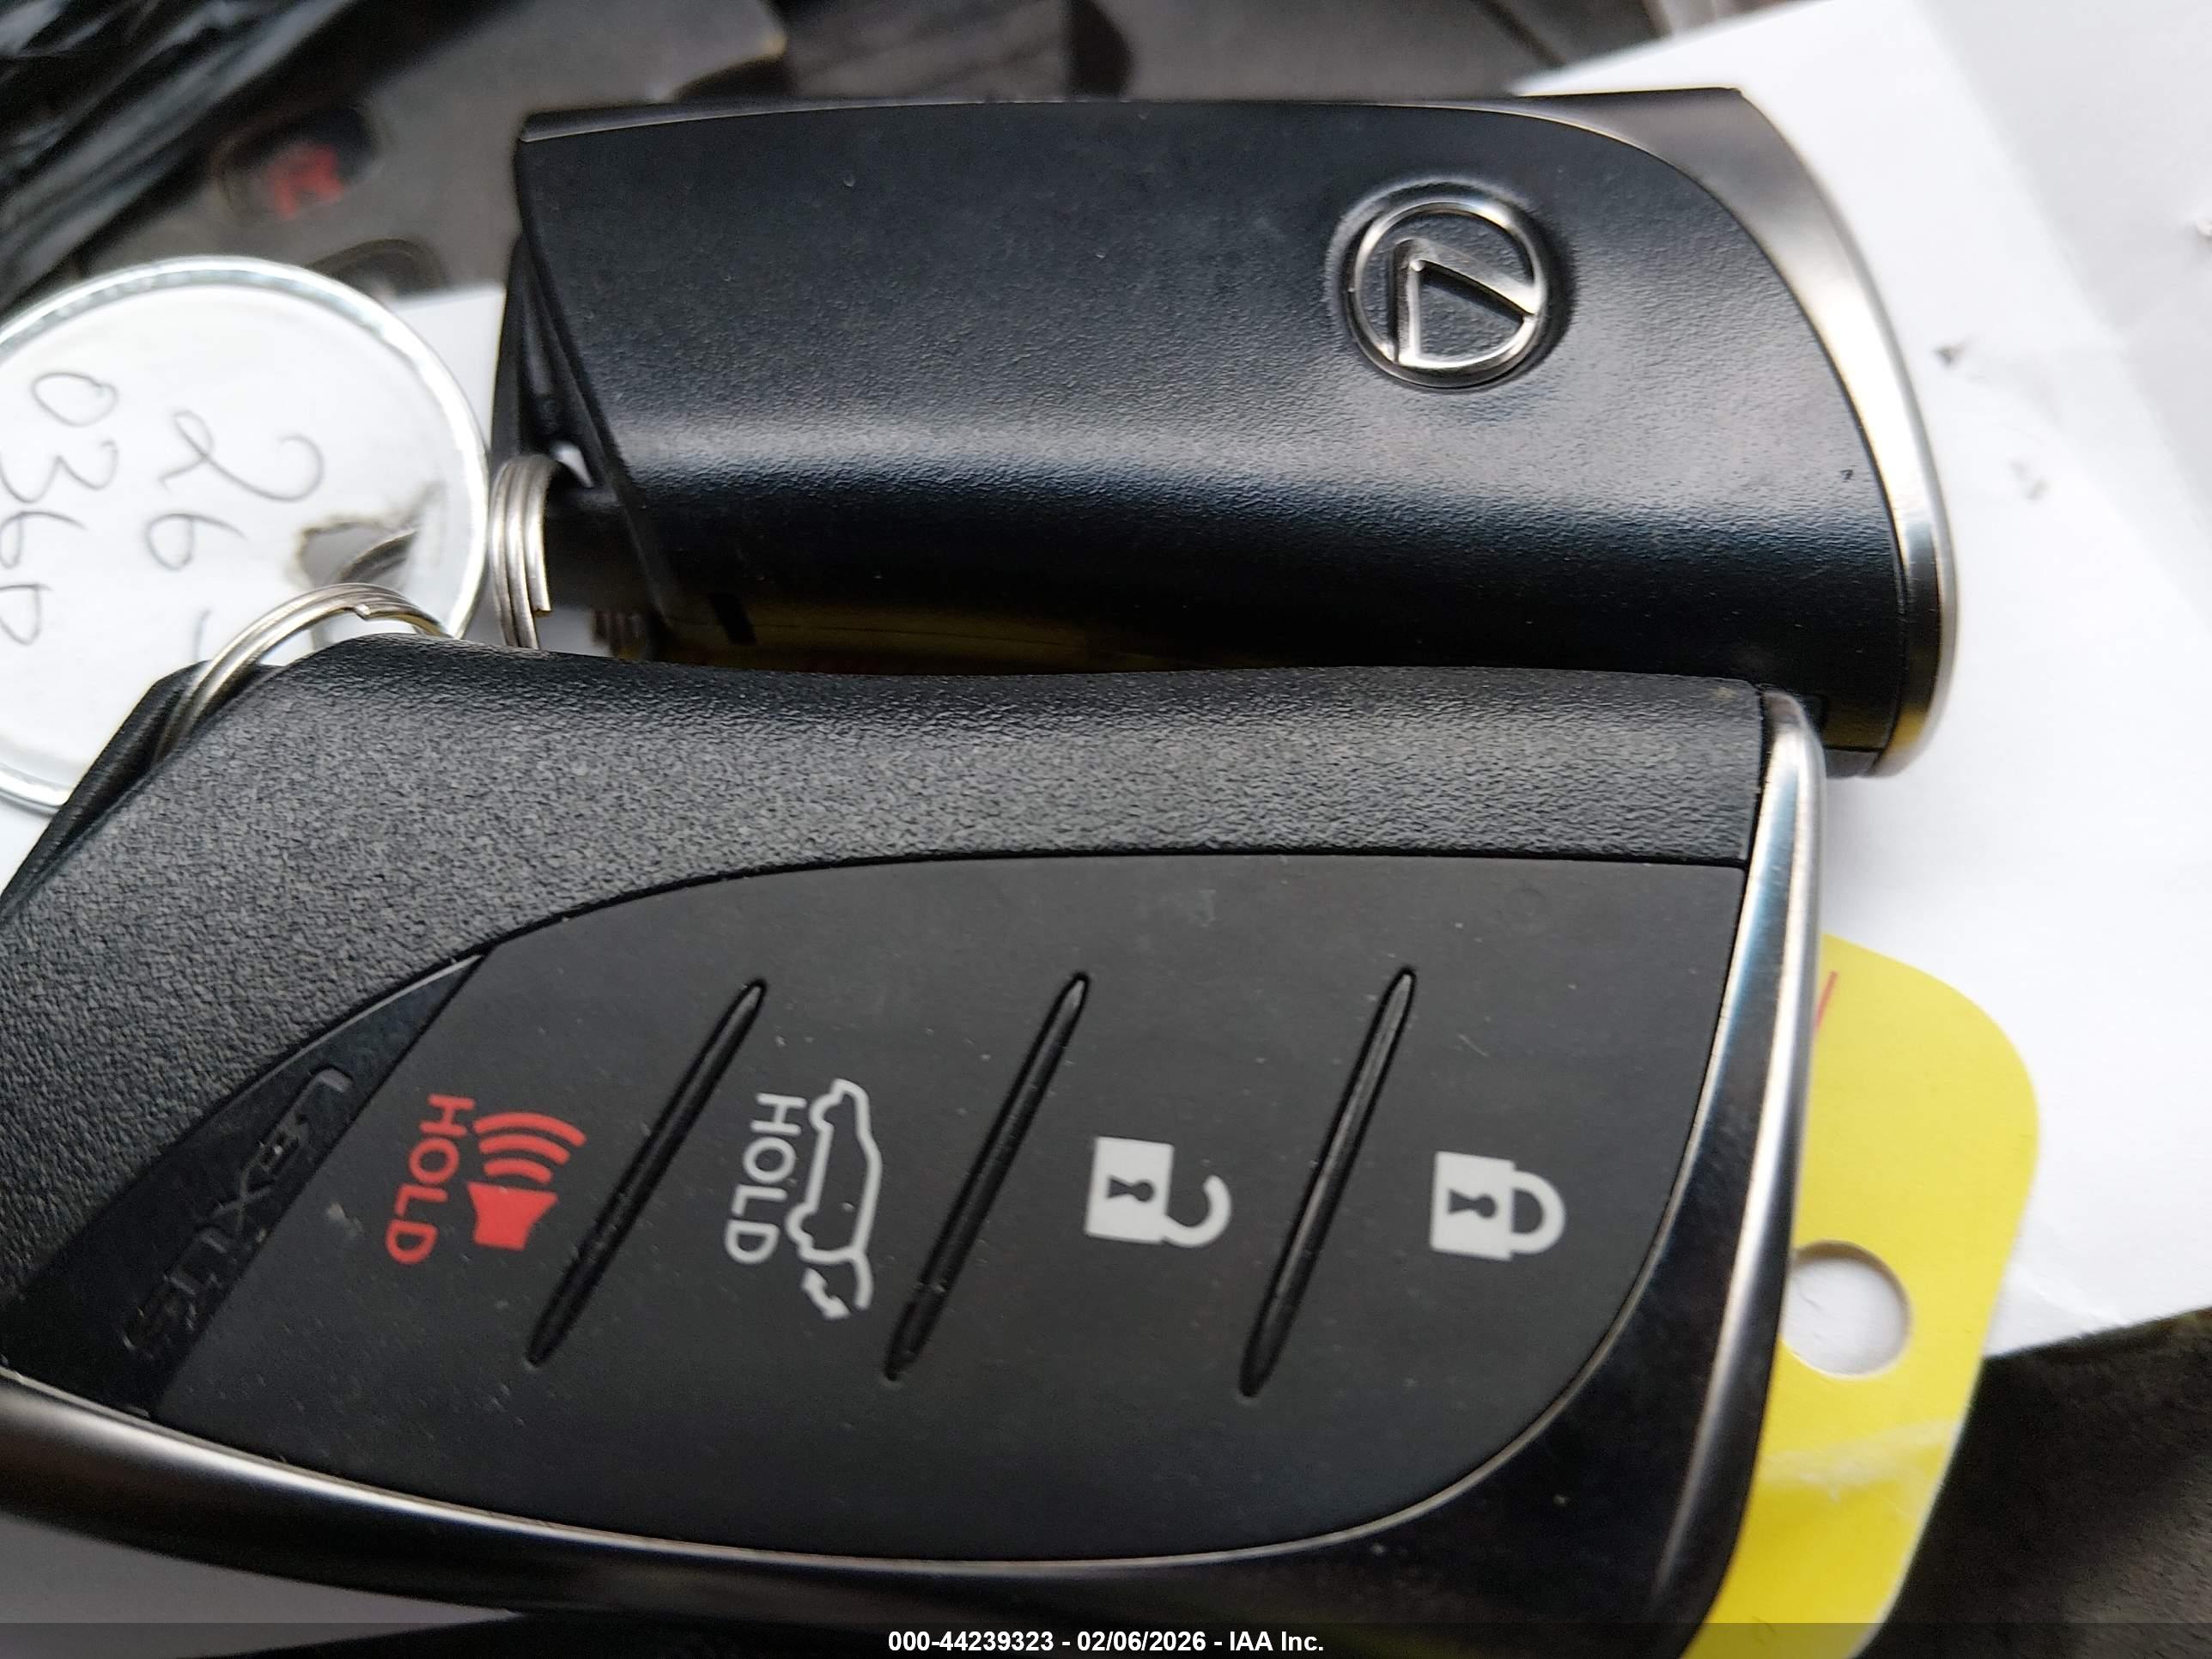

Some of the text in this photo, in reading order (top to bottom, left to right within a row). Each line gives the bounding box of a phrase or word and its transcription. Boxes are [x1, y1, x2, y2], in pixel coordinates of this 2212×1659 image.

[120, 1065, 352, 1358] LEXUS
[386, 1094, 475, 1265] HOLD
[725, 1092, 807, 1264] HOLD
